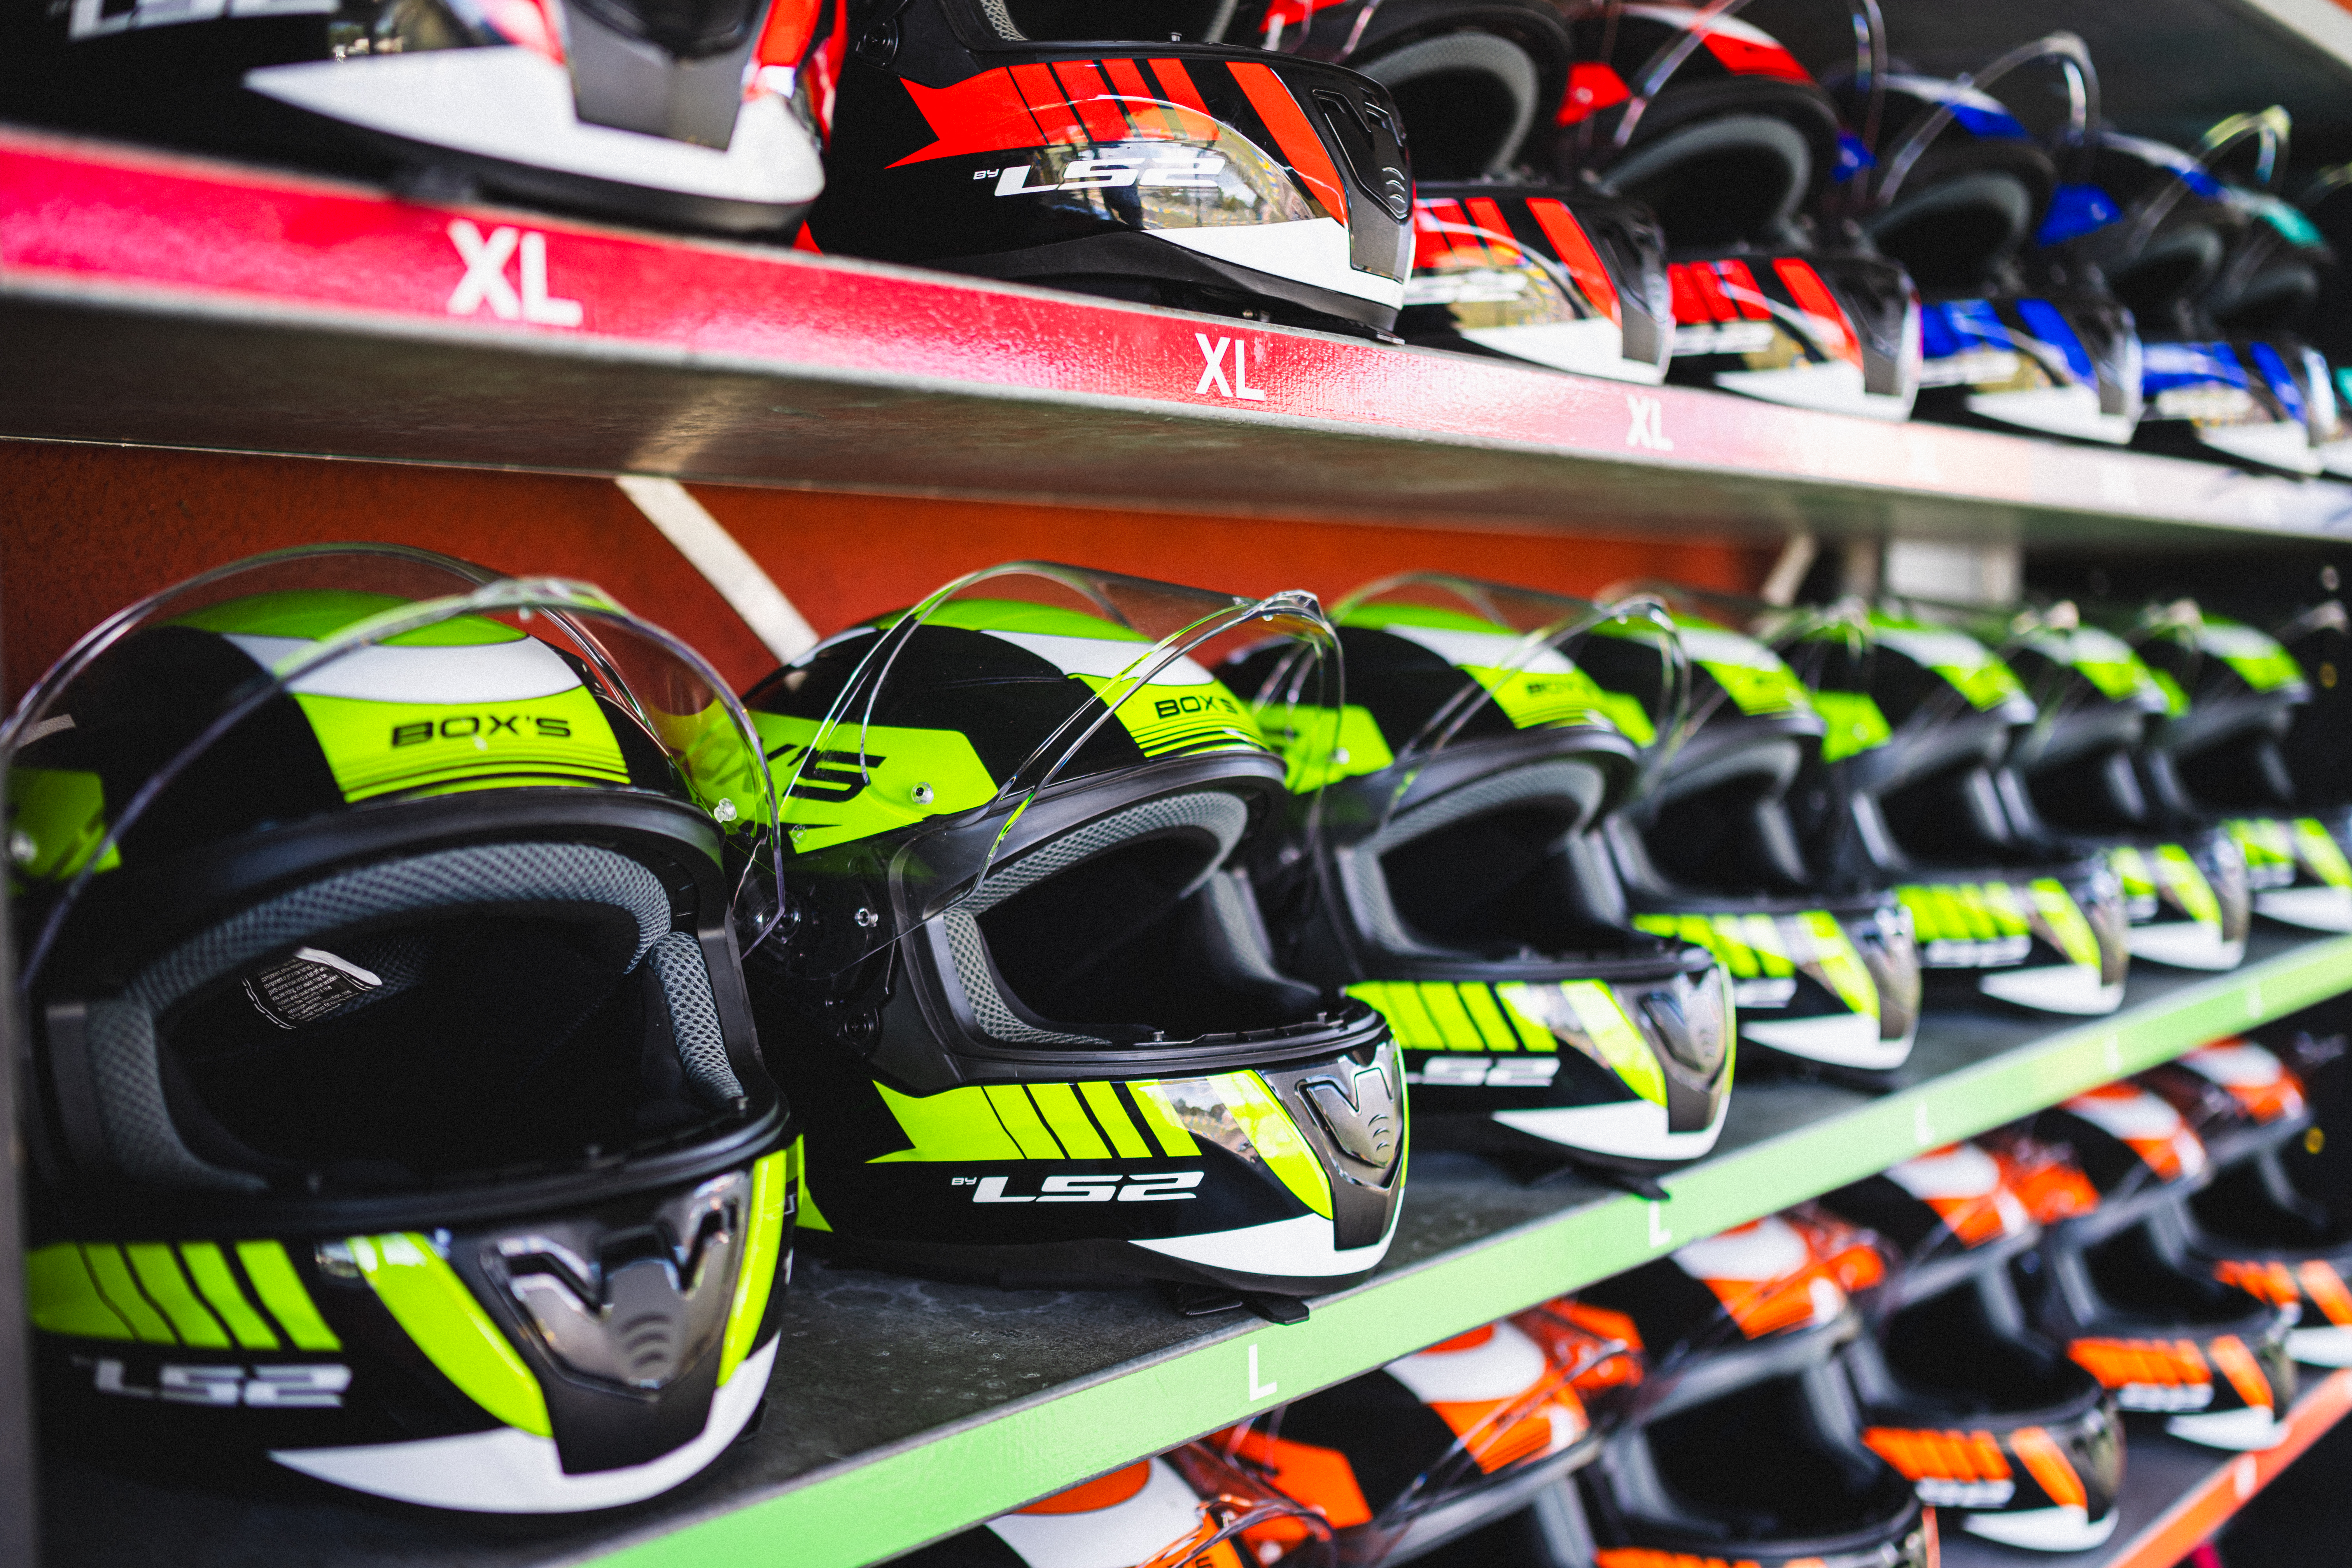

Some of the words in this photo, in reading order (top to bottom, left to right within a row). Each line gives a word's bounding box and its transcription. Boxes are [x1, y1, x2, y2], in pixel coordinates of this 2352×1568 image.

[973, 168, 999, 180] BY
[994, 158, 1225, 196] LS2
[446, 218, 583, 327] XL
[1195, 332, 1265, 402] XL
[1625, 394, 1674, 451] XL
[392, 715, 571, 748] BOX'S
[1406, 1056, 1561, 1087] S2
[952, 1176, 977, 1186] BY
[973, 1171, 1205, 1202] LS2
[1649, 1200, 1672, 1248] L
[1249, 1343, 1278, 1401] L
